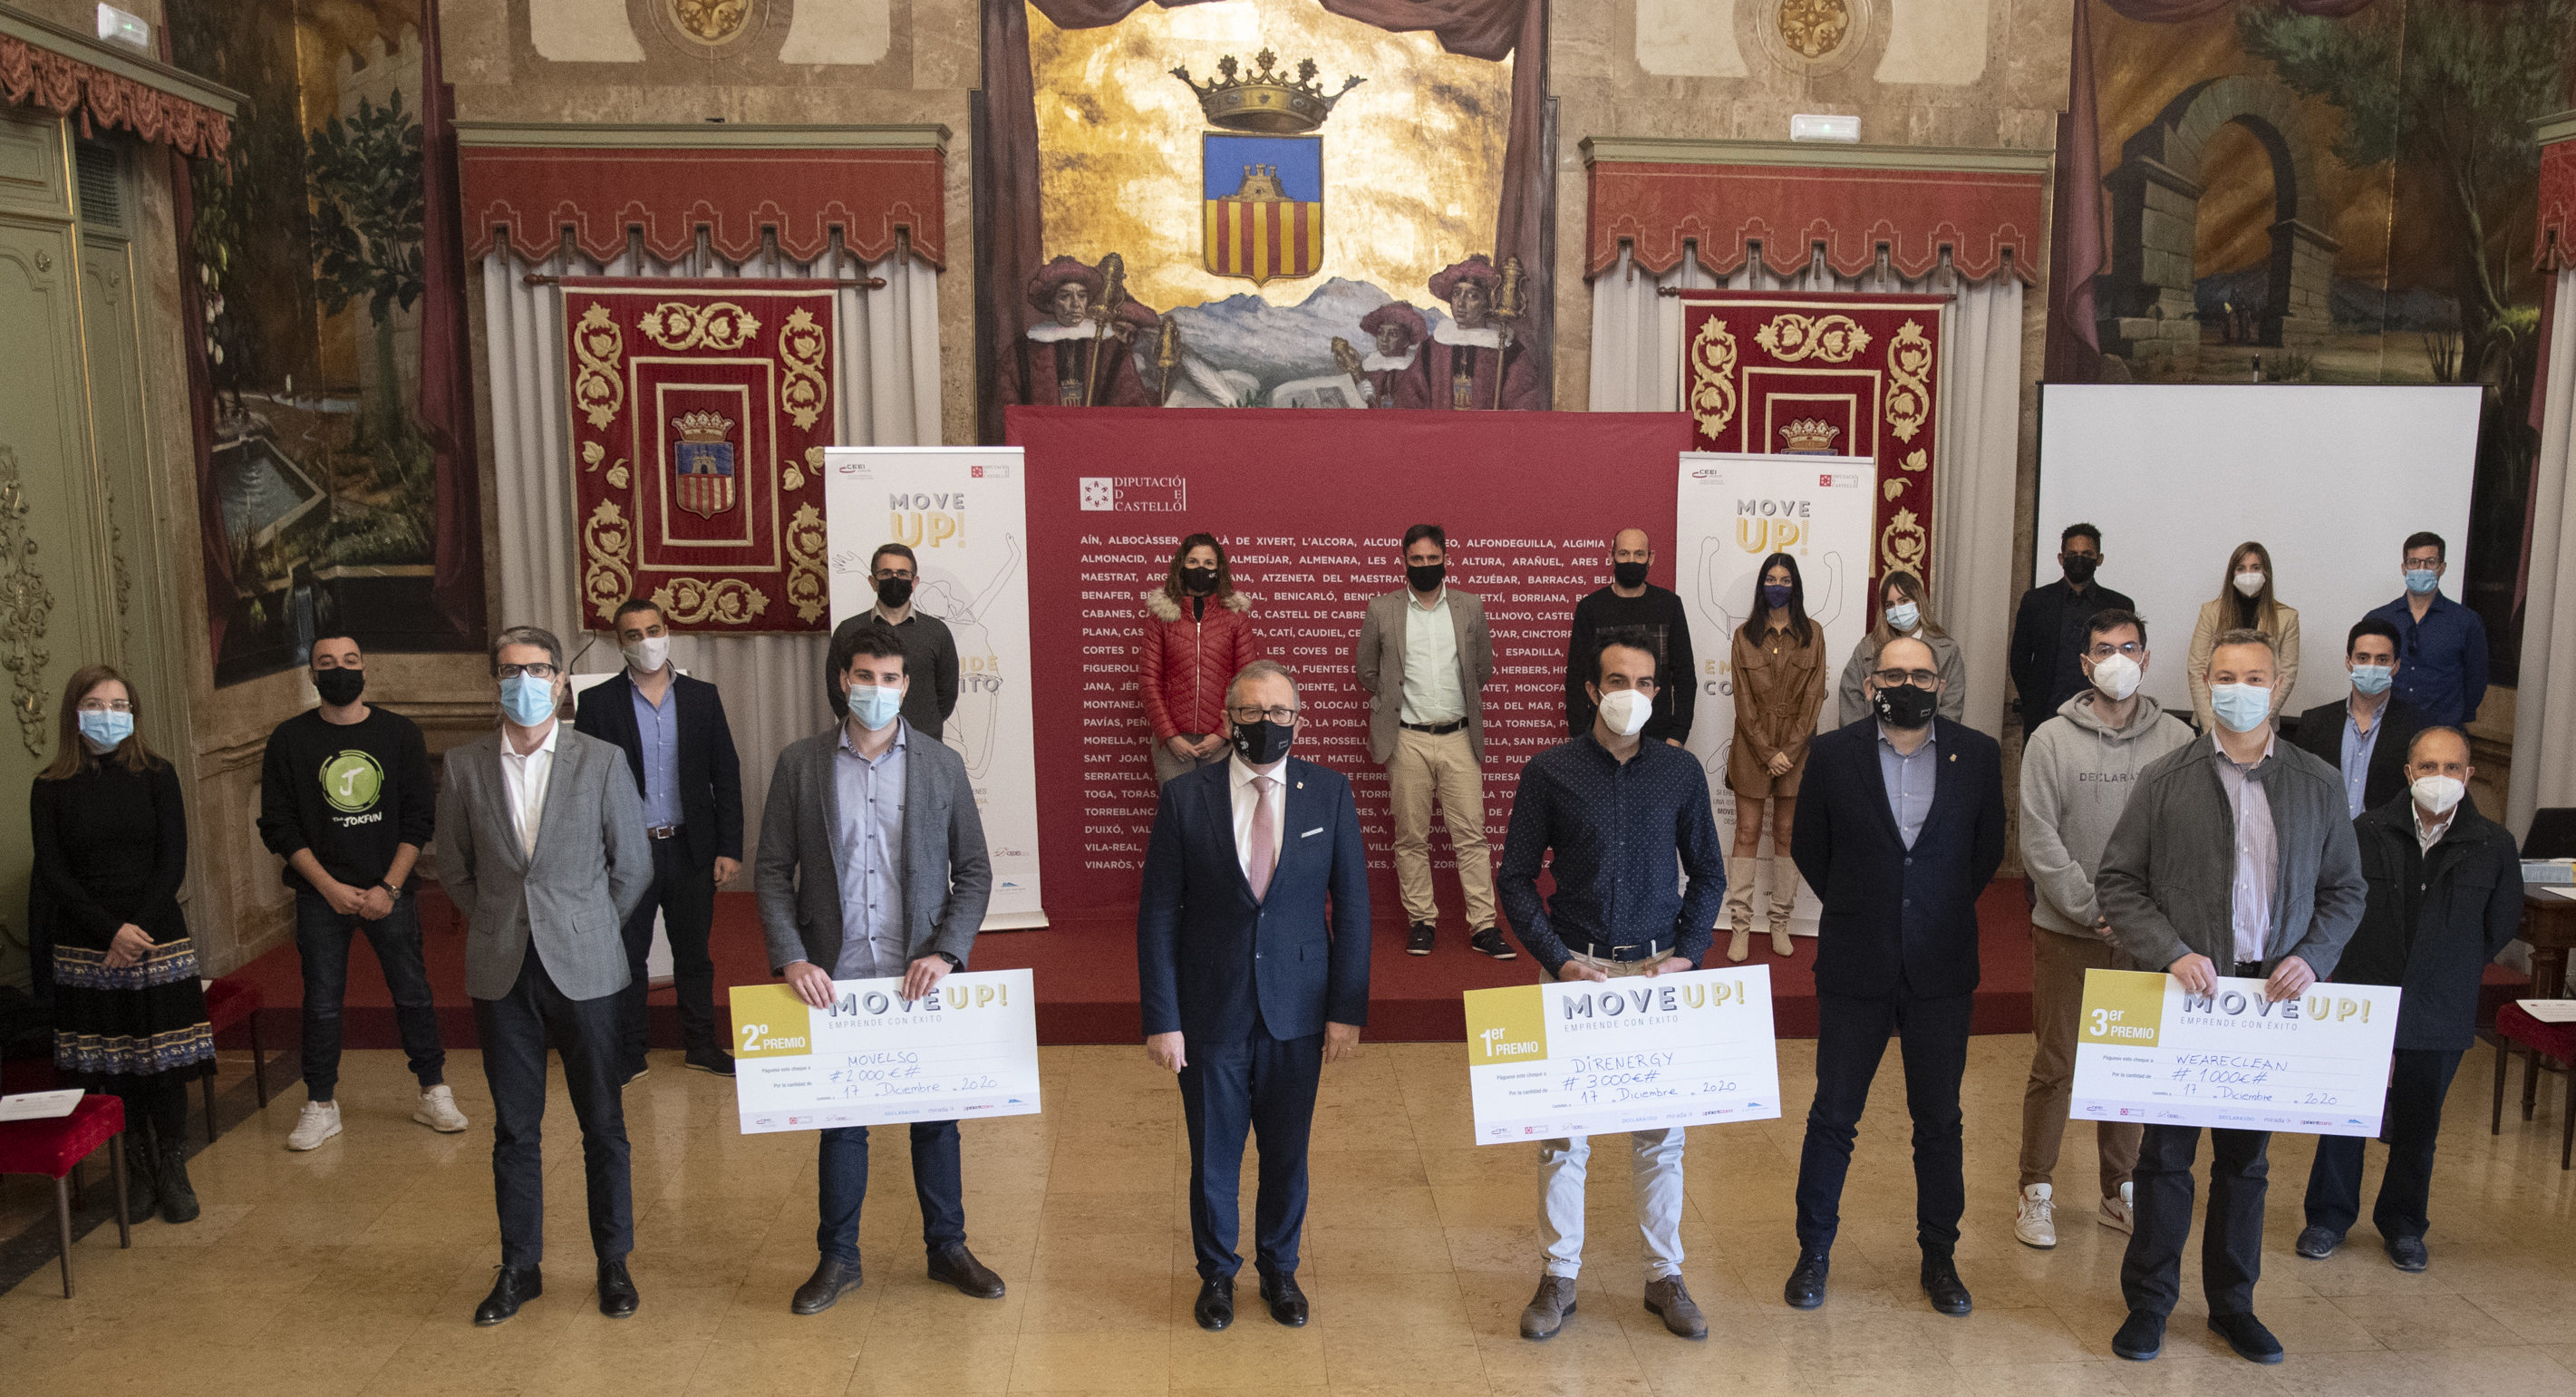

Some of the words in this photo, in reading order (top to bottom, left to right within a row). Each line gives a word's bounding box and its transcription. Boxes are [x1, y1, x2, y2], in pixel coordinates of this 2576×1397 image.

[1114, 475, 1182, 488] DIPUTACIÓ
[889, 493, 964, 510] MOVE
[1114, 500, 1182, 512] CASTELLÓ
[1738, 500, 1810, 518] MOVE
[890, 511, 965, 548] UP!
[1080, 534, 1102, 546] AÍN,
[1109, 534, 1182, 547] ALBOCÀSSER,
[1235, 537, 1250, 546] DE
[1256, 537, 1296, 547] XIVERT,
[1302, 538, 1357, 548] L'ALCORA,
[1363, 538, 1402, 547] ALCUDI
[1467, 539, 1556, 549] ALFONDEGUILLA,
[1563, 539, 1605, 548] ALGIMIA
[1736, 517, 1810, 557] UP!
[1080, 555, 1148, 565] ALMONACID,
[1229, 554, 1292, 566] ALMEDÍJAR,
[1299, 556, 1361, 566] ALMENARA,
[1368, 557, 1387, 565] LES
[1461, 558, 1506, 567] ALTURA,
[1512, 556, 1564, 568] ARAÑUEL,
[1571, 558, 1598, 567] ARES
[1081, 573, 1139, 583] MAESTRAT,
[1262, 574, 1316, 583] ATZENETA
[1323, 575, 1343, 583] DEL
[1351, 575, 1408, 585] MAESTRAT,
[1467, 574, 1521, 585] AZUÉBAR,
[1527, 576, 1587, 586] BARRACAS,
[1081, 591, 1134, 601] BENAFER,
[1274, 591, 1337, 602] BENICARLÓ,
[1479, 593, 1506, 603] ETXÍ,
[1512, 594, 1570, 604] BORRIANA,
[1082, 609, 1136, 620] CABANES,
[1265, 610, 1311, 619] CASTELL
[1313, 611, 1328, 619] DE
[1331, 611, 1366, 619] CABRE
[1082, 628, 1121, 638] PLANA,
[1269, 627, 1296, 638] CATÍ,
[1298, 628, 1346, 639] CAUDIEL,
[1082, 646, 1125, 655] CORTES
[1266, 647, 1286, 655] LES
[1293, 647, 1328, 655] COVES
[1335, 647, 1349, 655] DE
[1506, 648, 1564, 657] ESPADILLA,
[1303, 665, 1350, 674] FUENTES
[1501, 666, 1551, 675] HERBERS,
[1083, 683, 1115, 692] JANA,
[1297, 683, 1338, 694] DIENTE,
[1343, 684, 1357, 692] LA
[1482, 684, 1509, 694] ATET,
[1515, 684, 1566, 693] MONCOFA
[1314, 701, 1358, 710] OLOCAU
[1504, 702, 1524, 711] DEL
[1528, 702, 1554, 712] MAR,
[1083, 717, 1124, 728] PAVÍAS,
[1315, 719, 1329, 727] LA
[1332, 719, 1367, 727] POBLA
[1506, 720, 1556, 730] TORNESA,
[1084, 736, 1137, 747] MORELLA,
[1514, 737, 1535, 746] SAN
[1084, 754, 1112, 763] SANT
[1119, 754, 1148, 763] JOAN
[1328, 754, 1366, 764] MATEU,
[1485, 755, 1499, 763] DE
[1084, 772, 1153, 781] SERRATELLA,
[1084, 790, 1117, 800] TOGA,
[1121, 789, 1159, 799] TORÁS,
[344, 811, 382, 828] JOKFUN
[1489, 809, 1502, 817] DE
[1085, 824, 1124, 834] D'UIXÓ,
[1085, 843, 1142, 853] VILA-REAL,
[1085, 859, 1135, 869] VINARÒS,
[946, 984, 1008, 1010] UP!
[1563, 985, 1678, 1020] MOVE
[1681, 980, 1745, 1009] UP!
[2306, 995, 2371, 1024] UP!
[828, 1019, 884, 1030] EMPRENDE
[887, 1016, 908, 1025] CON
[1564, 1021, 1619, 1033] EMPRENDE
[1623, 1018, 1644, 1027] CON
[1649, 1014, 1679, 1024] ÉXITO
[2180, 1016, 2236, 1028] EMPRENDE
[2241, 1021, 2262, 1030] CON
[2267, 1022, 2299, 1032] ÉXITO
[2110, 1025, 2155, 1040] PREMIO
[762, 1036, 806, 1050] PREMIO
[1496, 1041, 1539, 1056] PREMIO
[847, 1052, 918, 1067] MOVELSO
